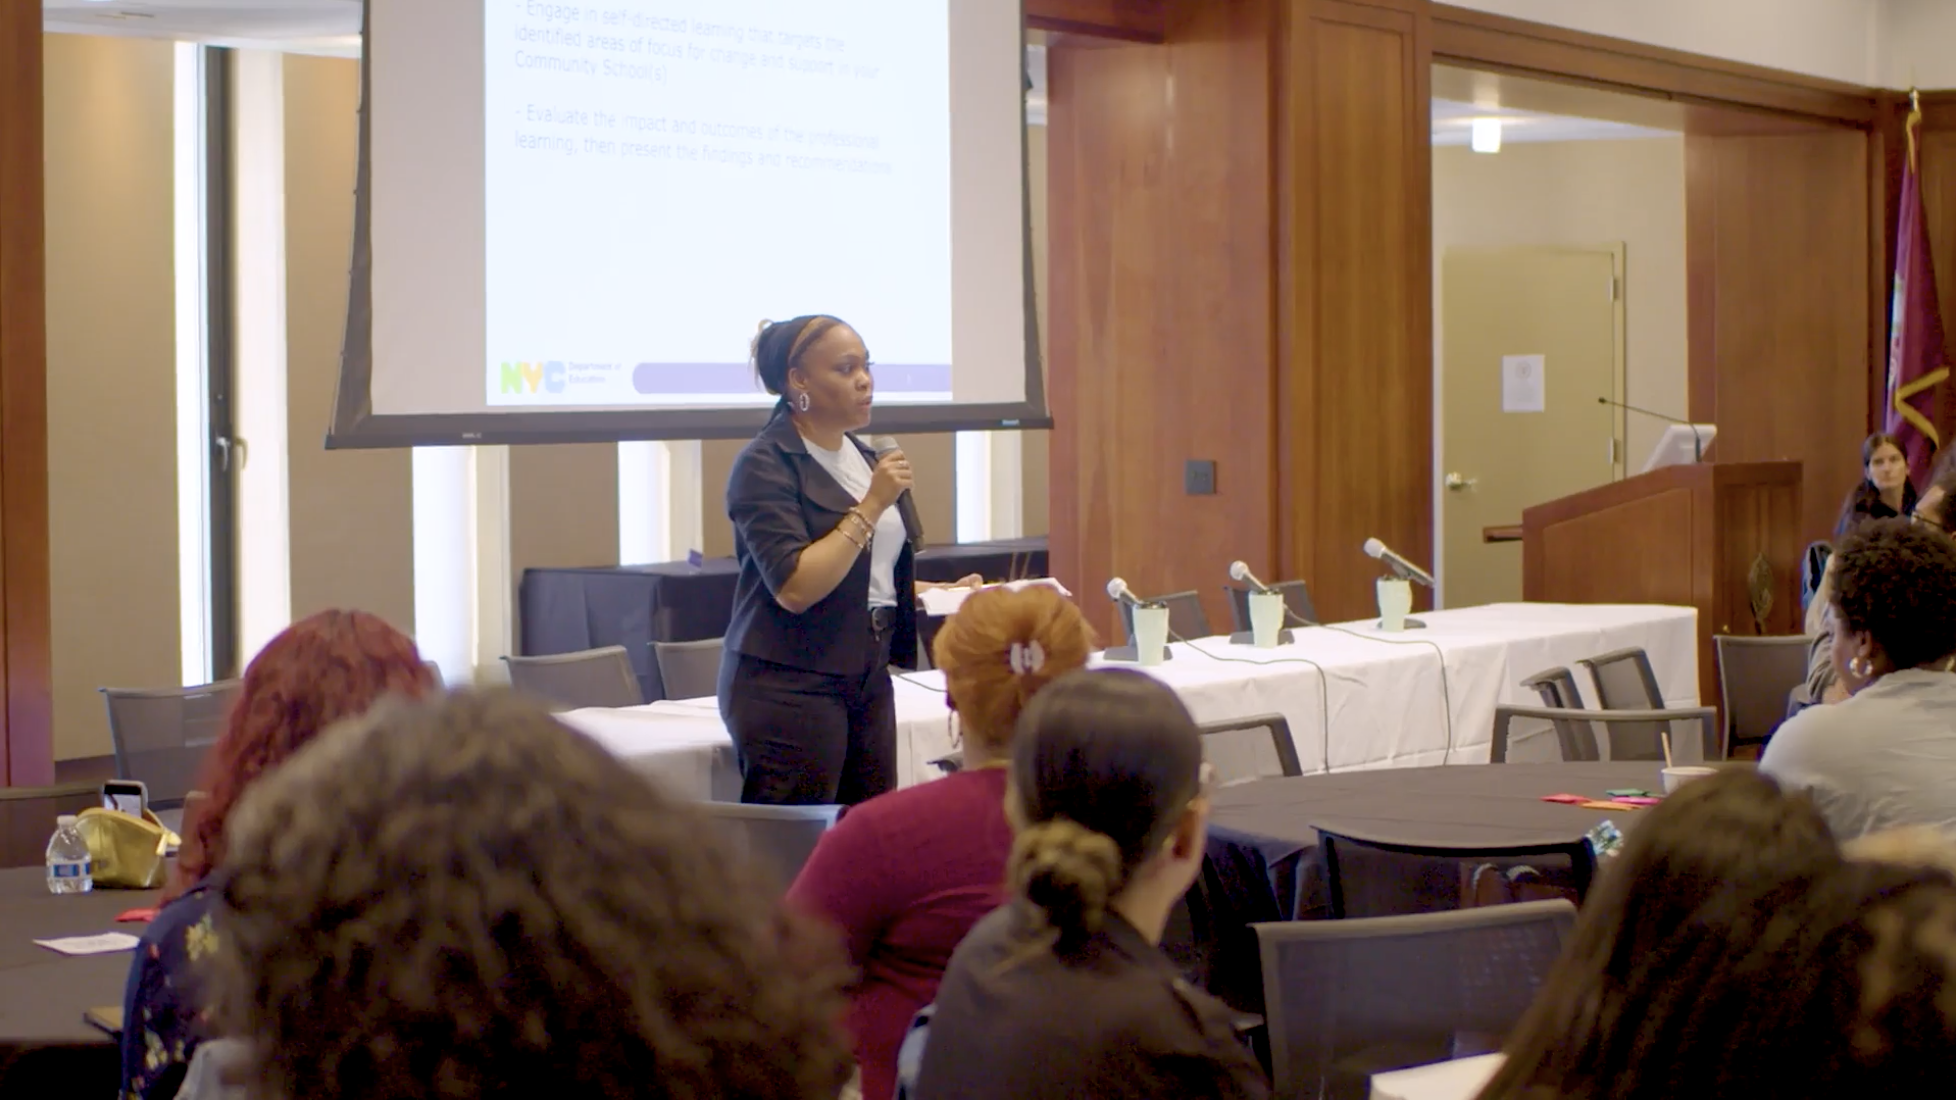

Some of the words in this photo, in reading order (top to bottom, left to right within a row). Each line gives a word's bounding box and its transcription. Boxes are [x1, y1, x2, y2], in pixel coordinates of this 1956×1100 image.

[526, 0, 580, 24] Engage
[584, 8, 597, 22] in
[602, 9, 687, 33] self-directed
[691, 18, 743, 44] learning
[748, 25, 774, 43] that
[778, 30, 822, 50] targets
[514, 50, 598, 76] Community
[602, 58, 668, 86] School(s)
[587, 33, 625, 52] areas
[629, 36, 644, 53] of
[648, 39, 683, 58] focus
[687, 42, 706, 60] for
[709, 47, 757, 70] change
[761, 53, 784, 69] and
[788, 56, 834, 76] support
[526, 103, 589, 126] Evaluate
[593, 109, 616, 128] the
[621, 113, 667, 133] impact
[672, 118, 697, 135] and
[701, 122, 763, 140] outcomes
[767, 123, 781, 141] of
[784, 127, 804, 143] the
[808, 129, 880, 151] professional
[514, 130, 579, 155] learning,
[583, 135, 616, 154] then
[621, 141, 672, 160] present
[676, 143, 698, 161] the
[702, 144, 753, 168] findings
[758, 152, 781, 168] and
[501, 361, 566, 393] NYC
[568, 361, 613, 373] Department
[568, 374, 606, 384] Education
